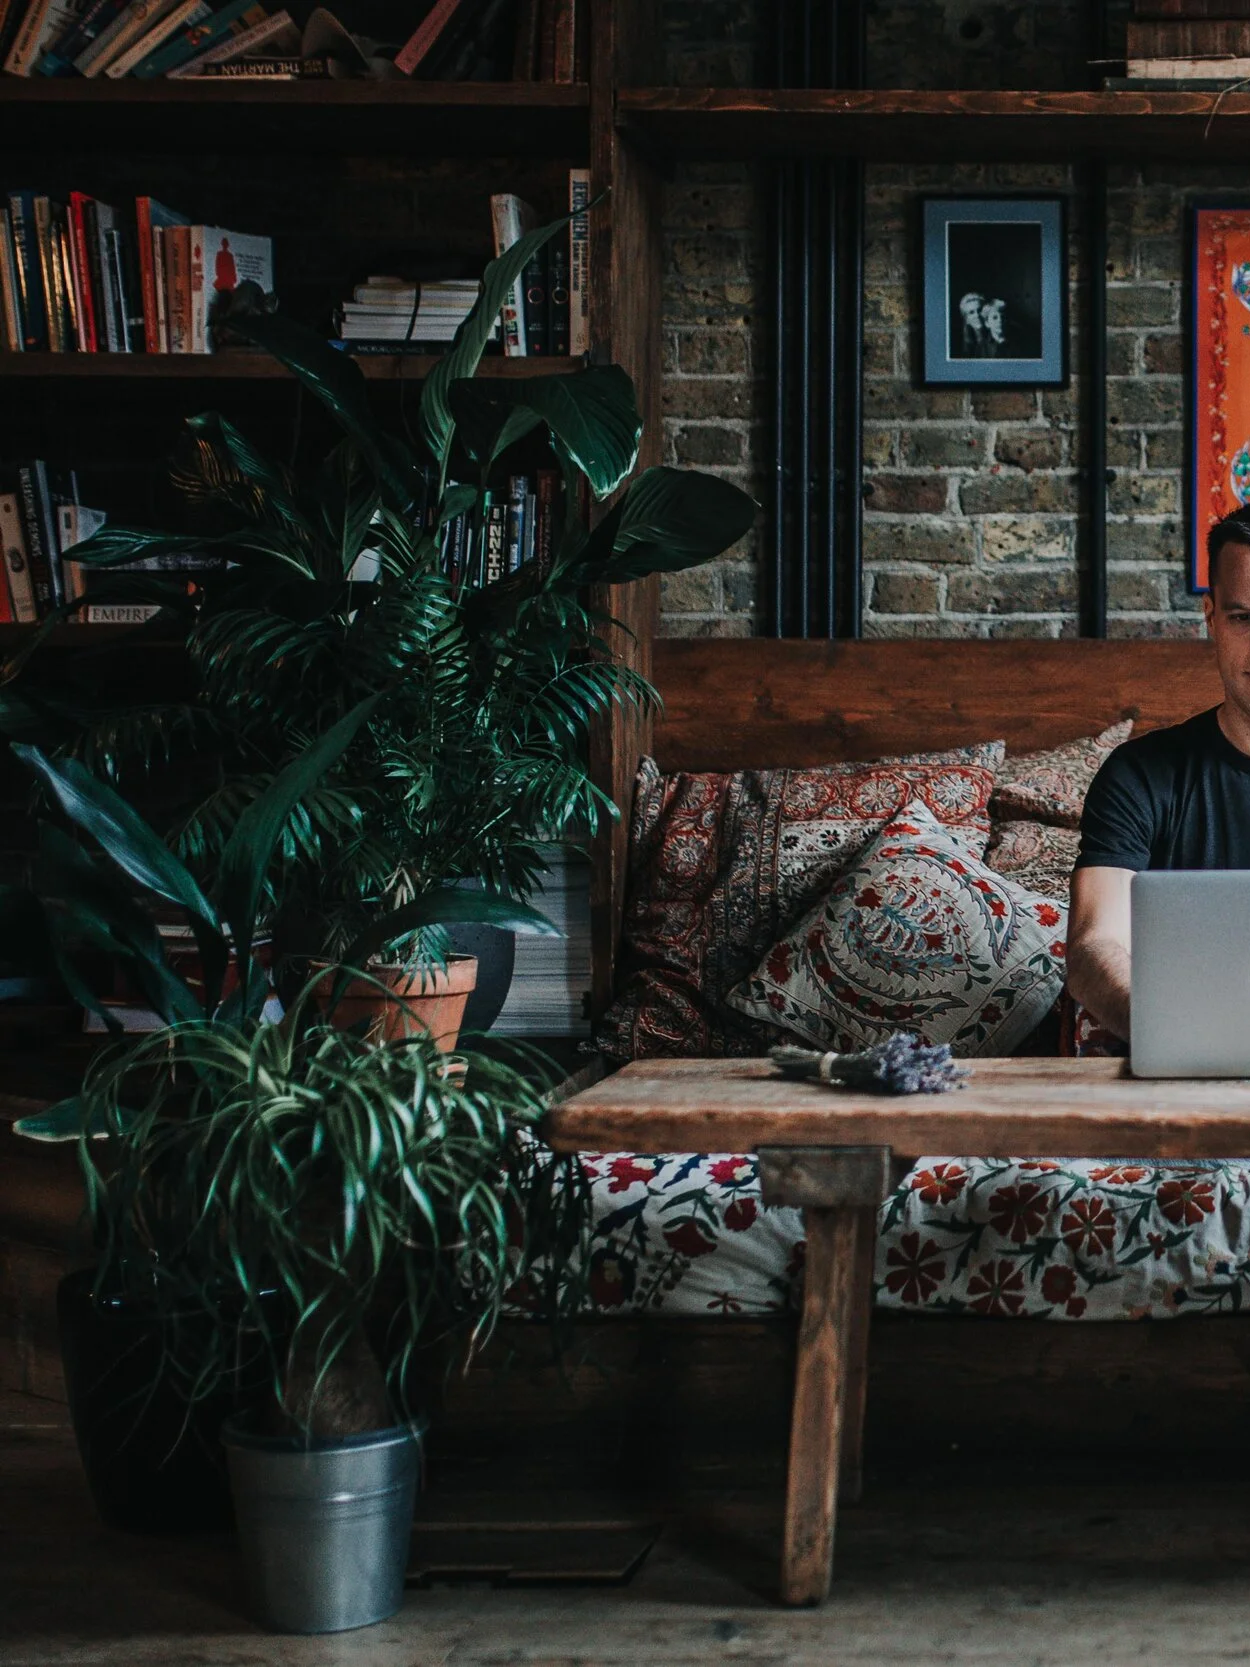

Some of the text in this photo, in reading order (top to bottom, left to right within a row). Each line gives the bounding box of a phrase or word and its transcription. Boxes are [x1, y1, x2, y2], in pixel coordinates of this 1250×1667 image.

[221, 63, 275, 76] MARTIAN
[277, 62, 300, 73] THE
[26, 521, 43, 557] DEMONS
[487, 524, 502, 585] CH-22
[93, 607, 151, 621] EMPIRE
